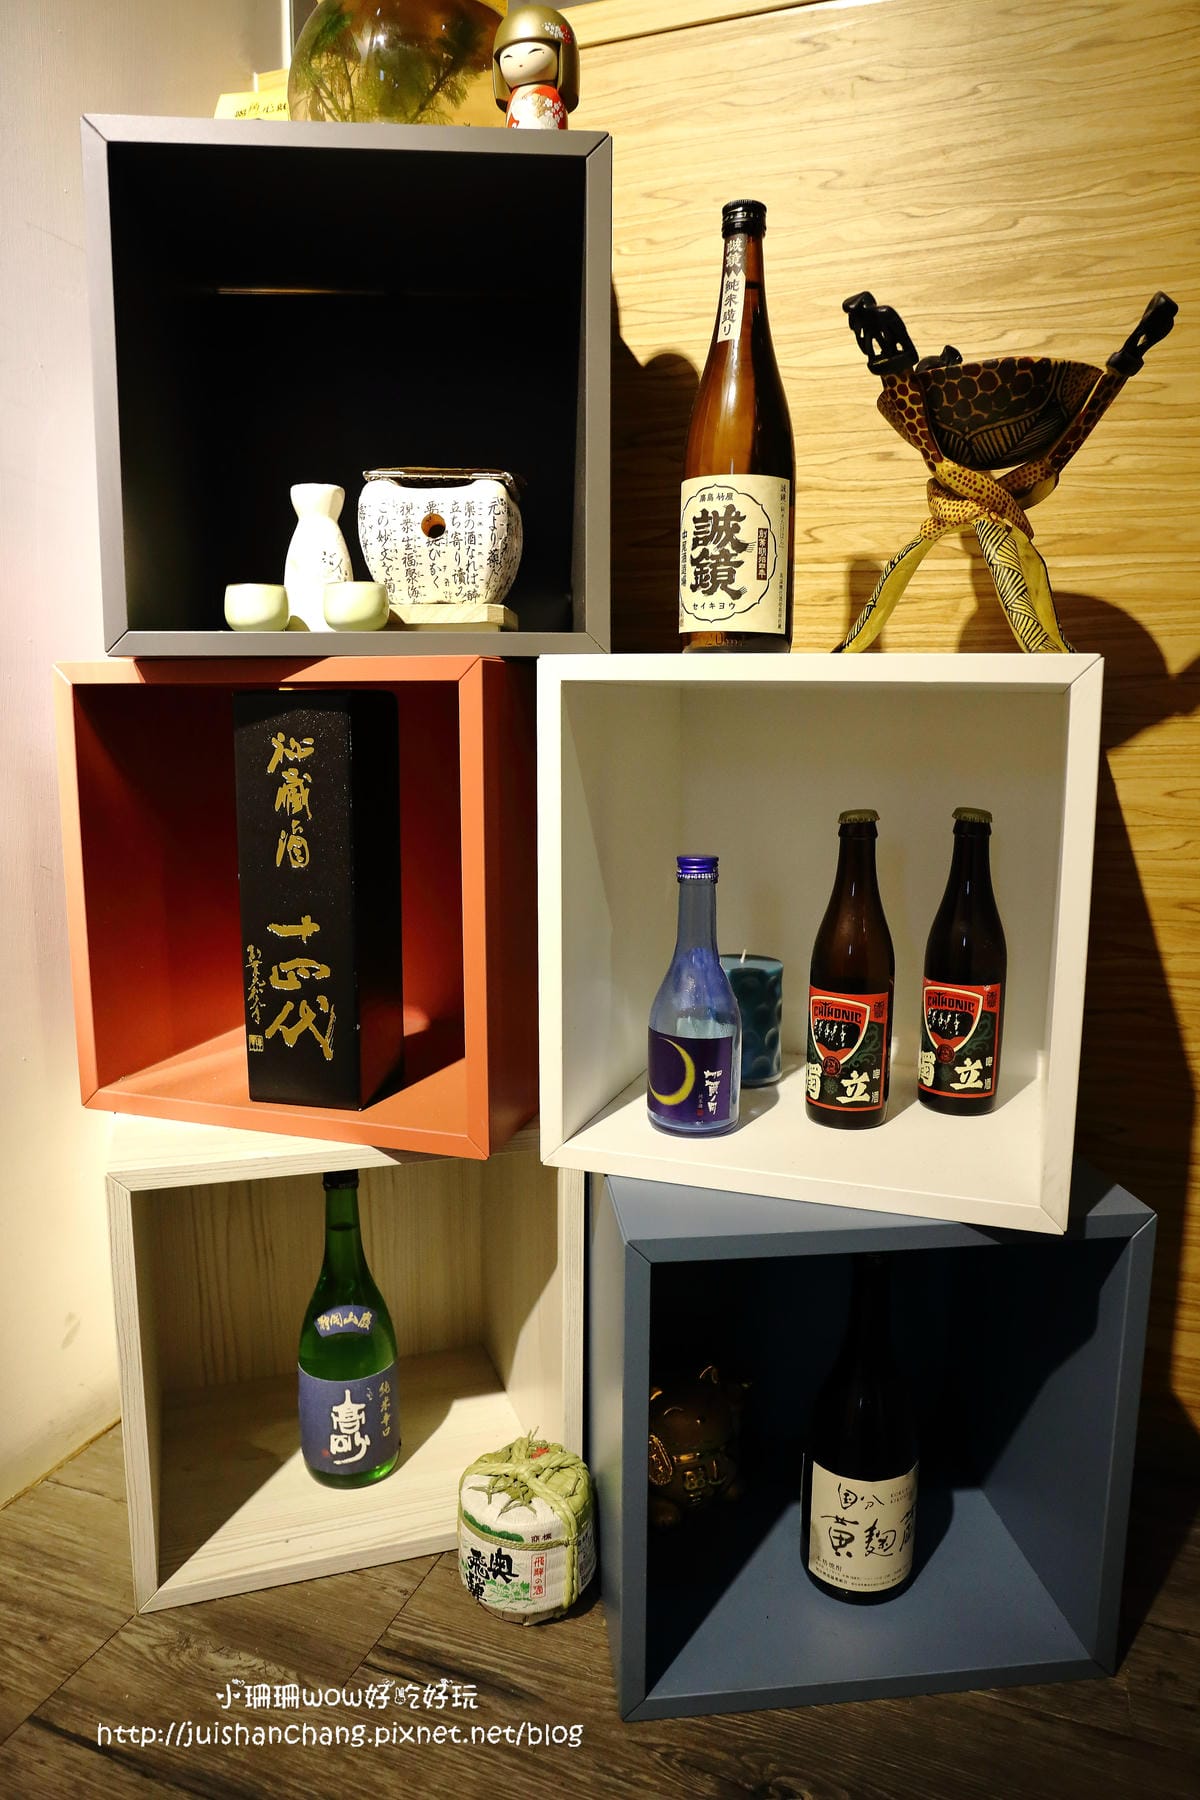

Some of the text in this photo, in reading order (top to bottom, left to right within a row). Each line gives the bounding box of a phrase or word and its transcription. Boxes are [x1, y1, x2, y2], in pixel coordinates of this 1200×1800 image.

[725, 238, 744, 267] 誠鏡
[722, 279, 740, 336] 純米造り
[690, 503, 750, 601] 誠鏡
[692, 602, 736, 611] セイキヨウ
[265, 915, 337, 1061] 十四代
[927, 991, 975, 1014] CHTHONIC
[813, 1001, 862, 1024] CHTHONIC
[329, 1389, 371, 1465] 高砂
